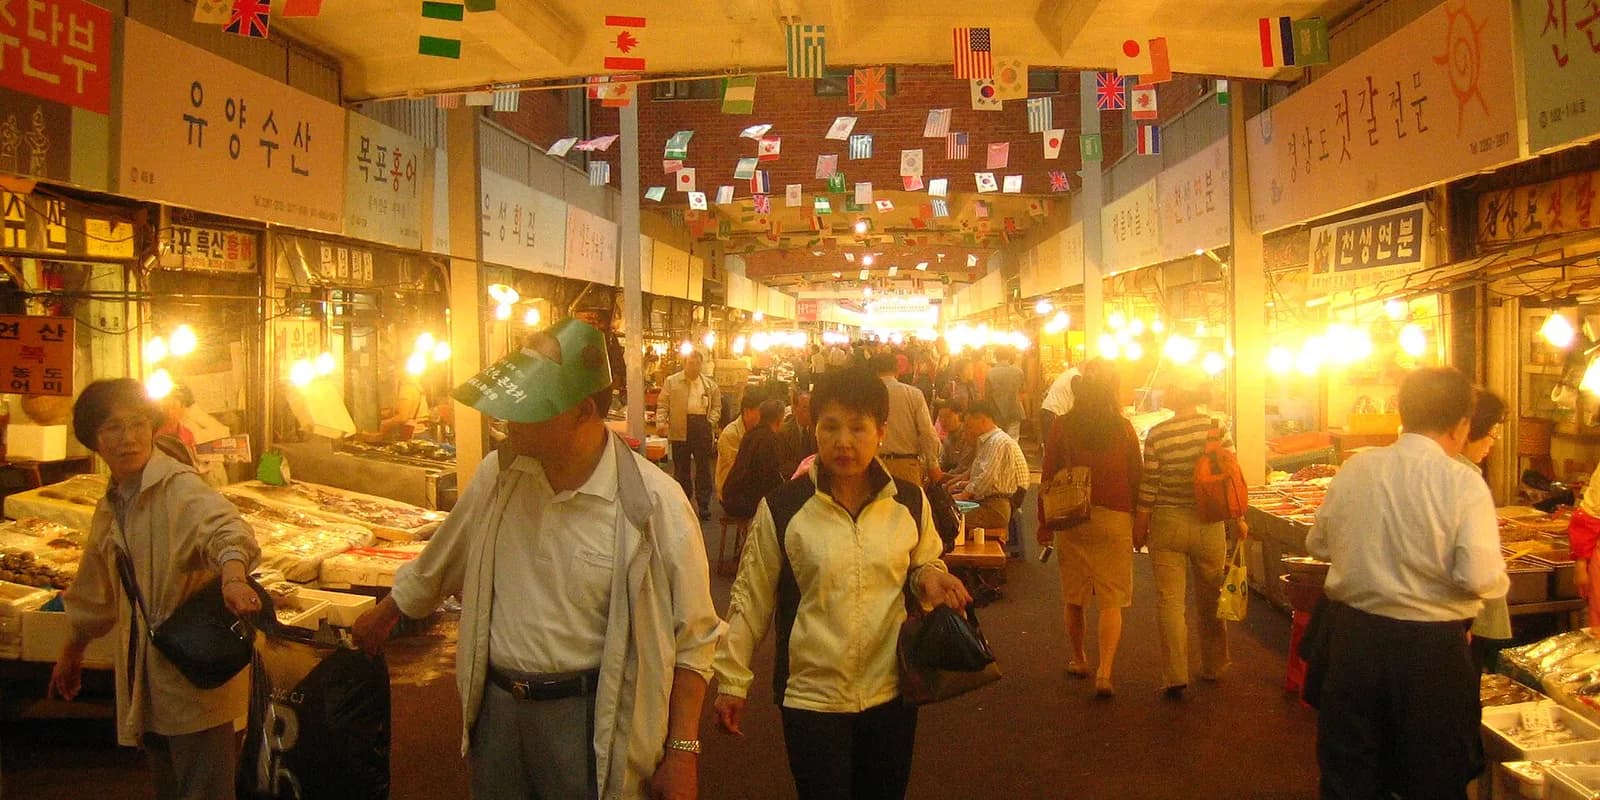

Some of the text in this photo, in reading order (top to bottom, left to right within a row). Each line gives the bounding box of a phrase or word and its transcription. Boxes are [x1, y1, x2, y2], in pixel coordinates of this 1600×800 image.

[183, 80, 312, 176] 유양수산
[357, 135, 416, 198] 목포홍어
[1288, 71, 1428, 183] 경상도 젓갈 전문
[1340, 217, 1414, 265] 천생연분
